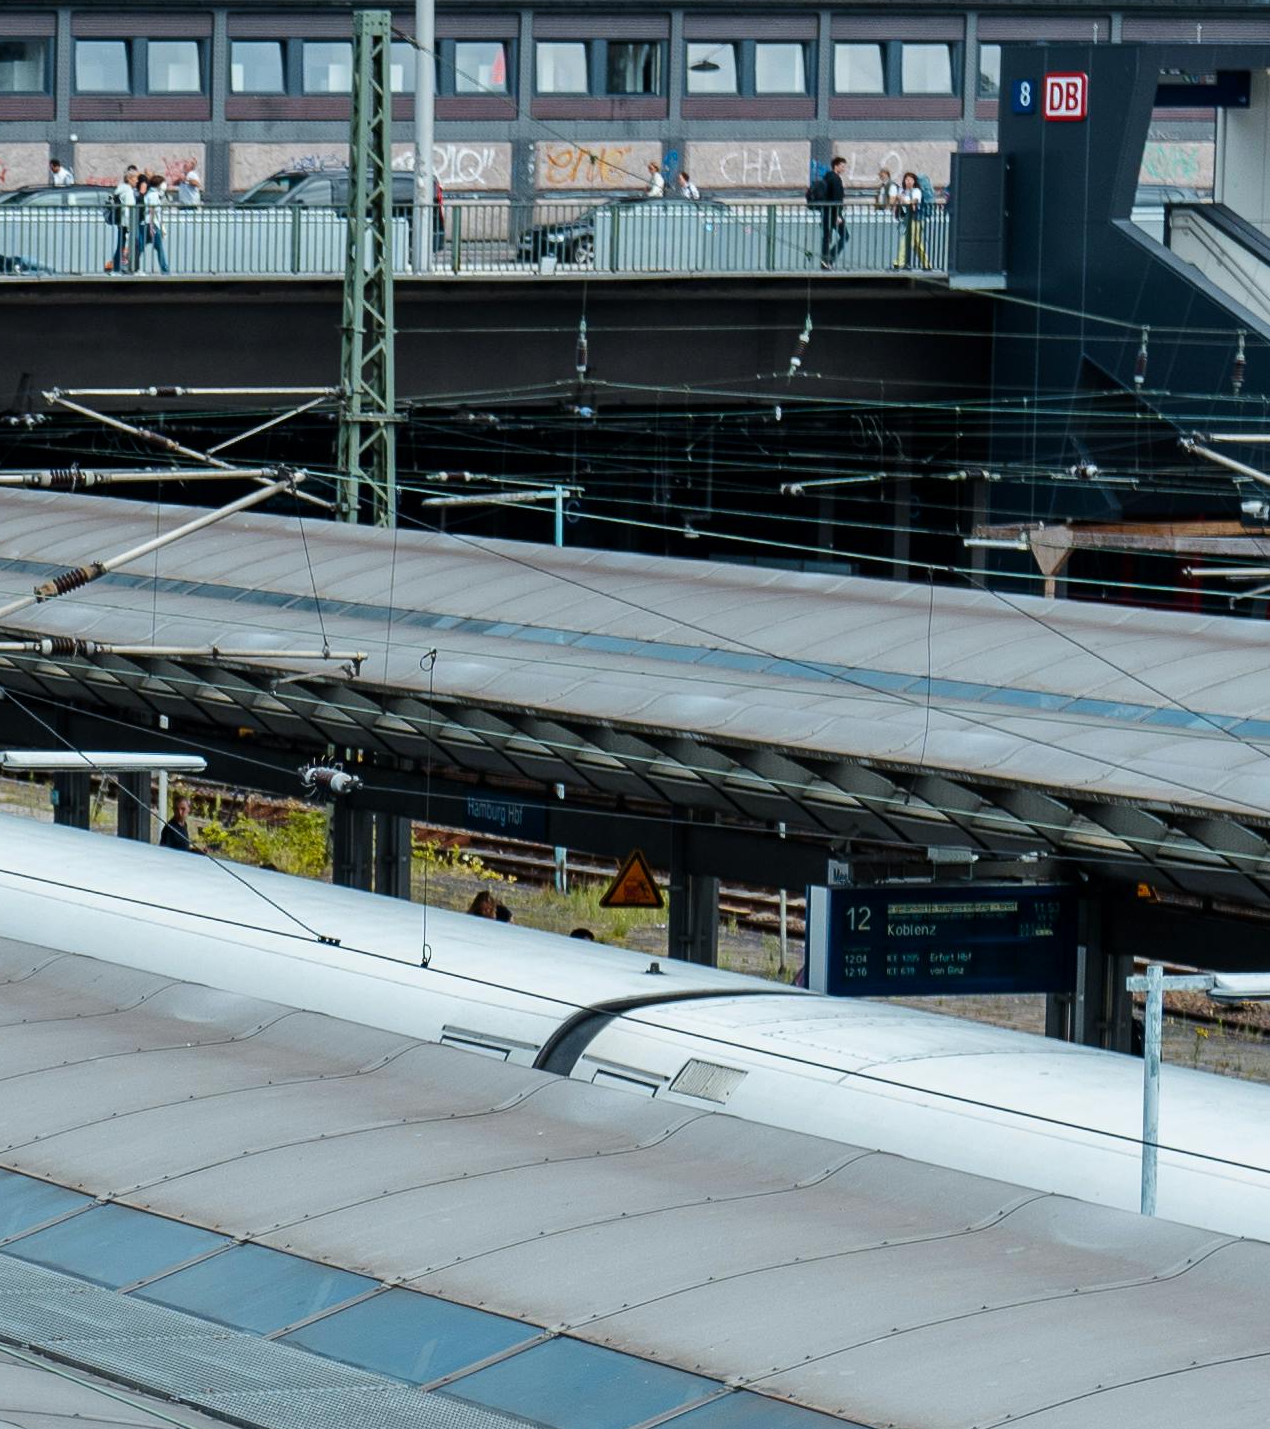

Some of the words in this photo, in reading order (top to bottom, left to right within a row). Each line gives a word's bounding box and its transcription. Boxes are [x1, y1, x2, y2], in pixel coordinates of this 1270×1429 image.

[1020, 81, 1031, 107] 8
[1049, 81, 1079, 111] DB
[467, 796, 506, 828] Hamburg
[507, 803, 524, 826] Hbf
[845, 905, 871, 932] 12
[887, 923, 937, 937] Koblenz
[929, 952, 954, 963] Erfurt
